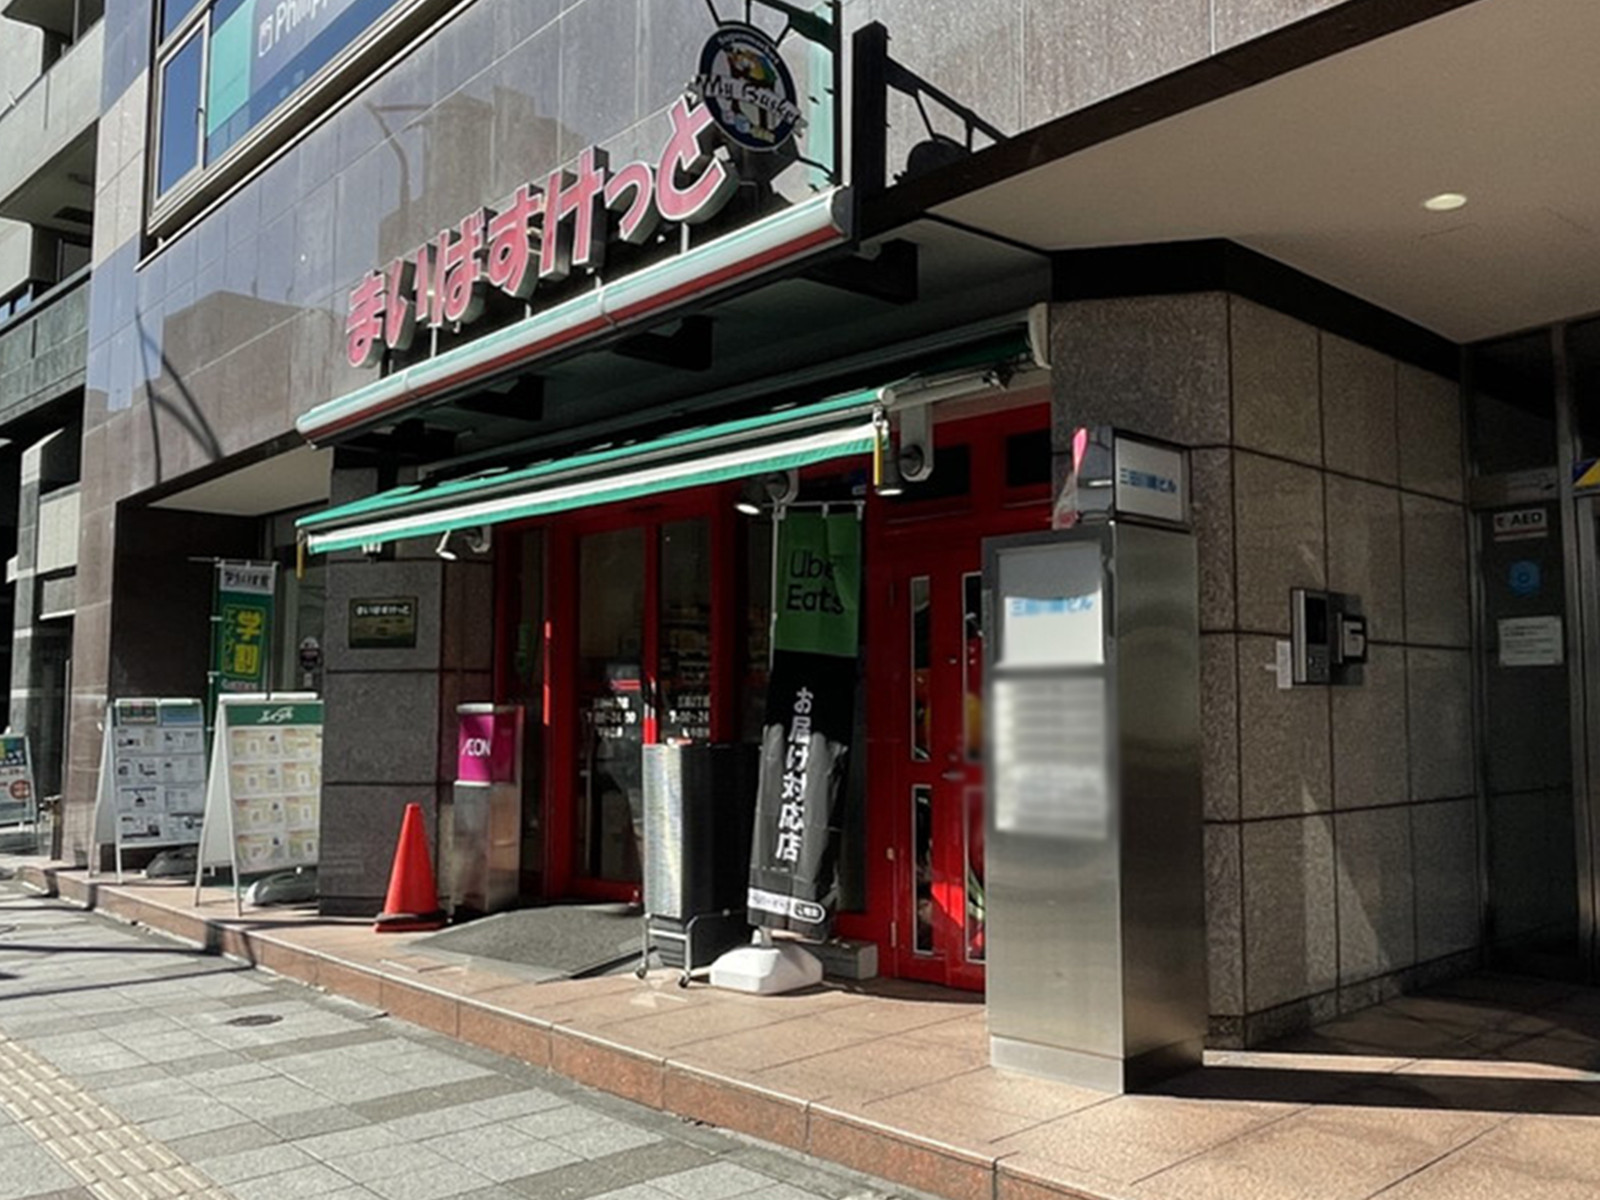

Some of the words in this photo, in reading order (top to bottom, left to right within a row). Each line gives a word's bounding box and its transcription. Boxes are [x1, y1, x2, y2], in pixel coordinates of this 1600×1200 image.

[346, 96, 727, 367] まいばすけっと
[1511, 512, 1543, 526] AED
[790, 549, 836, 579] Ube
[786, 584, 845, 615] Eats
[774, 687, 814, 863] お届け対応店
